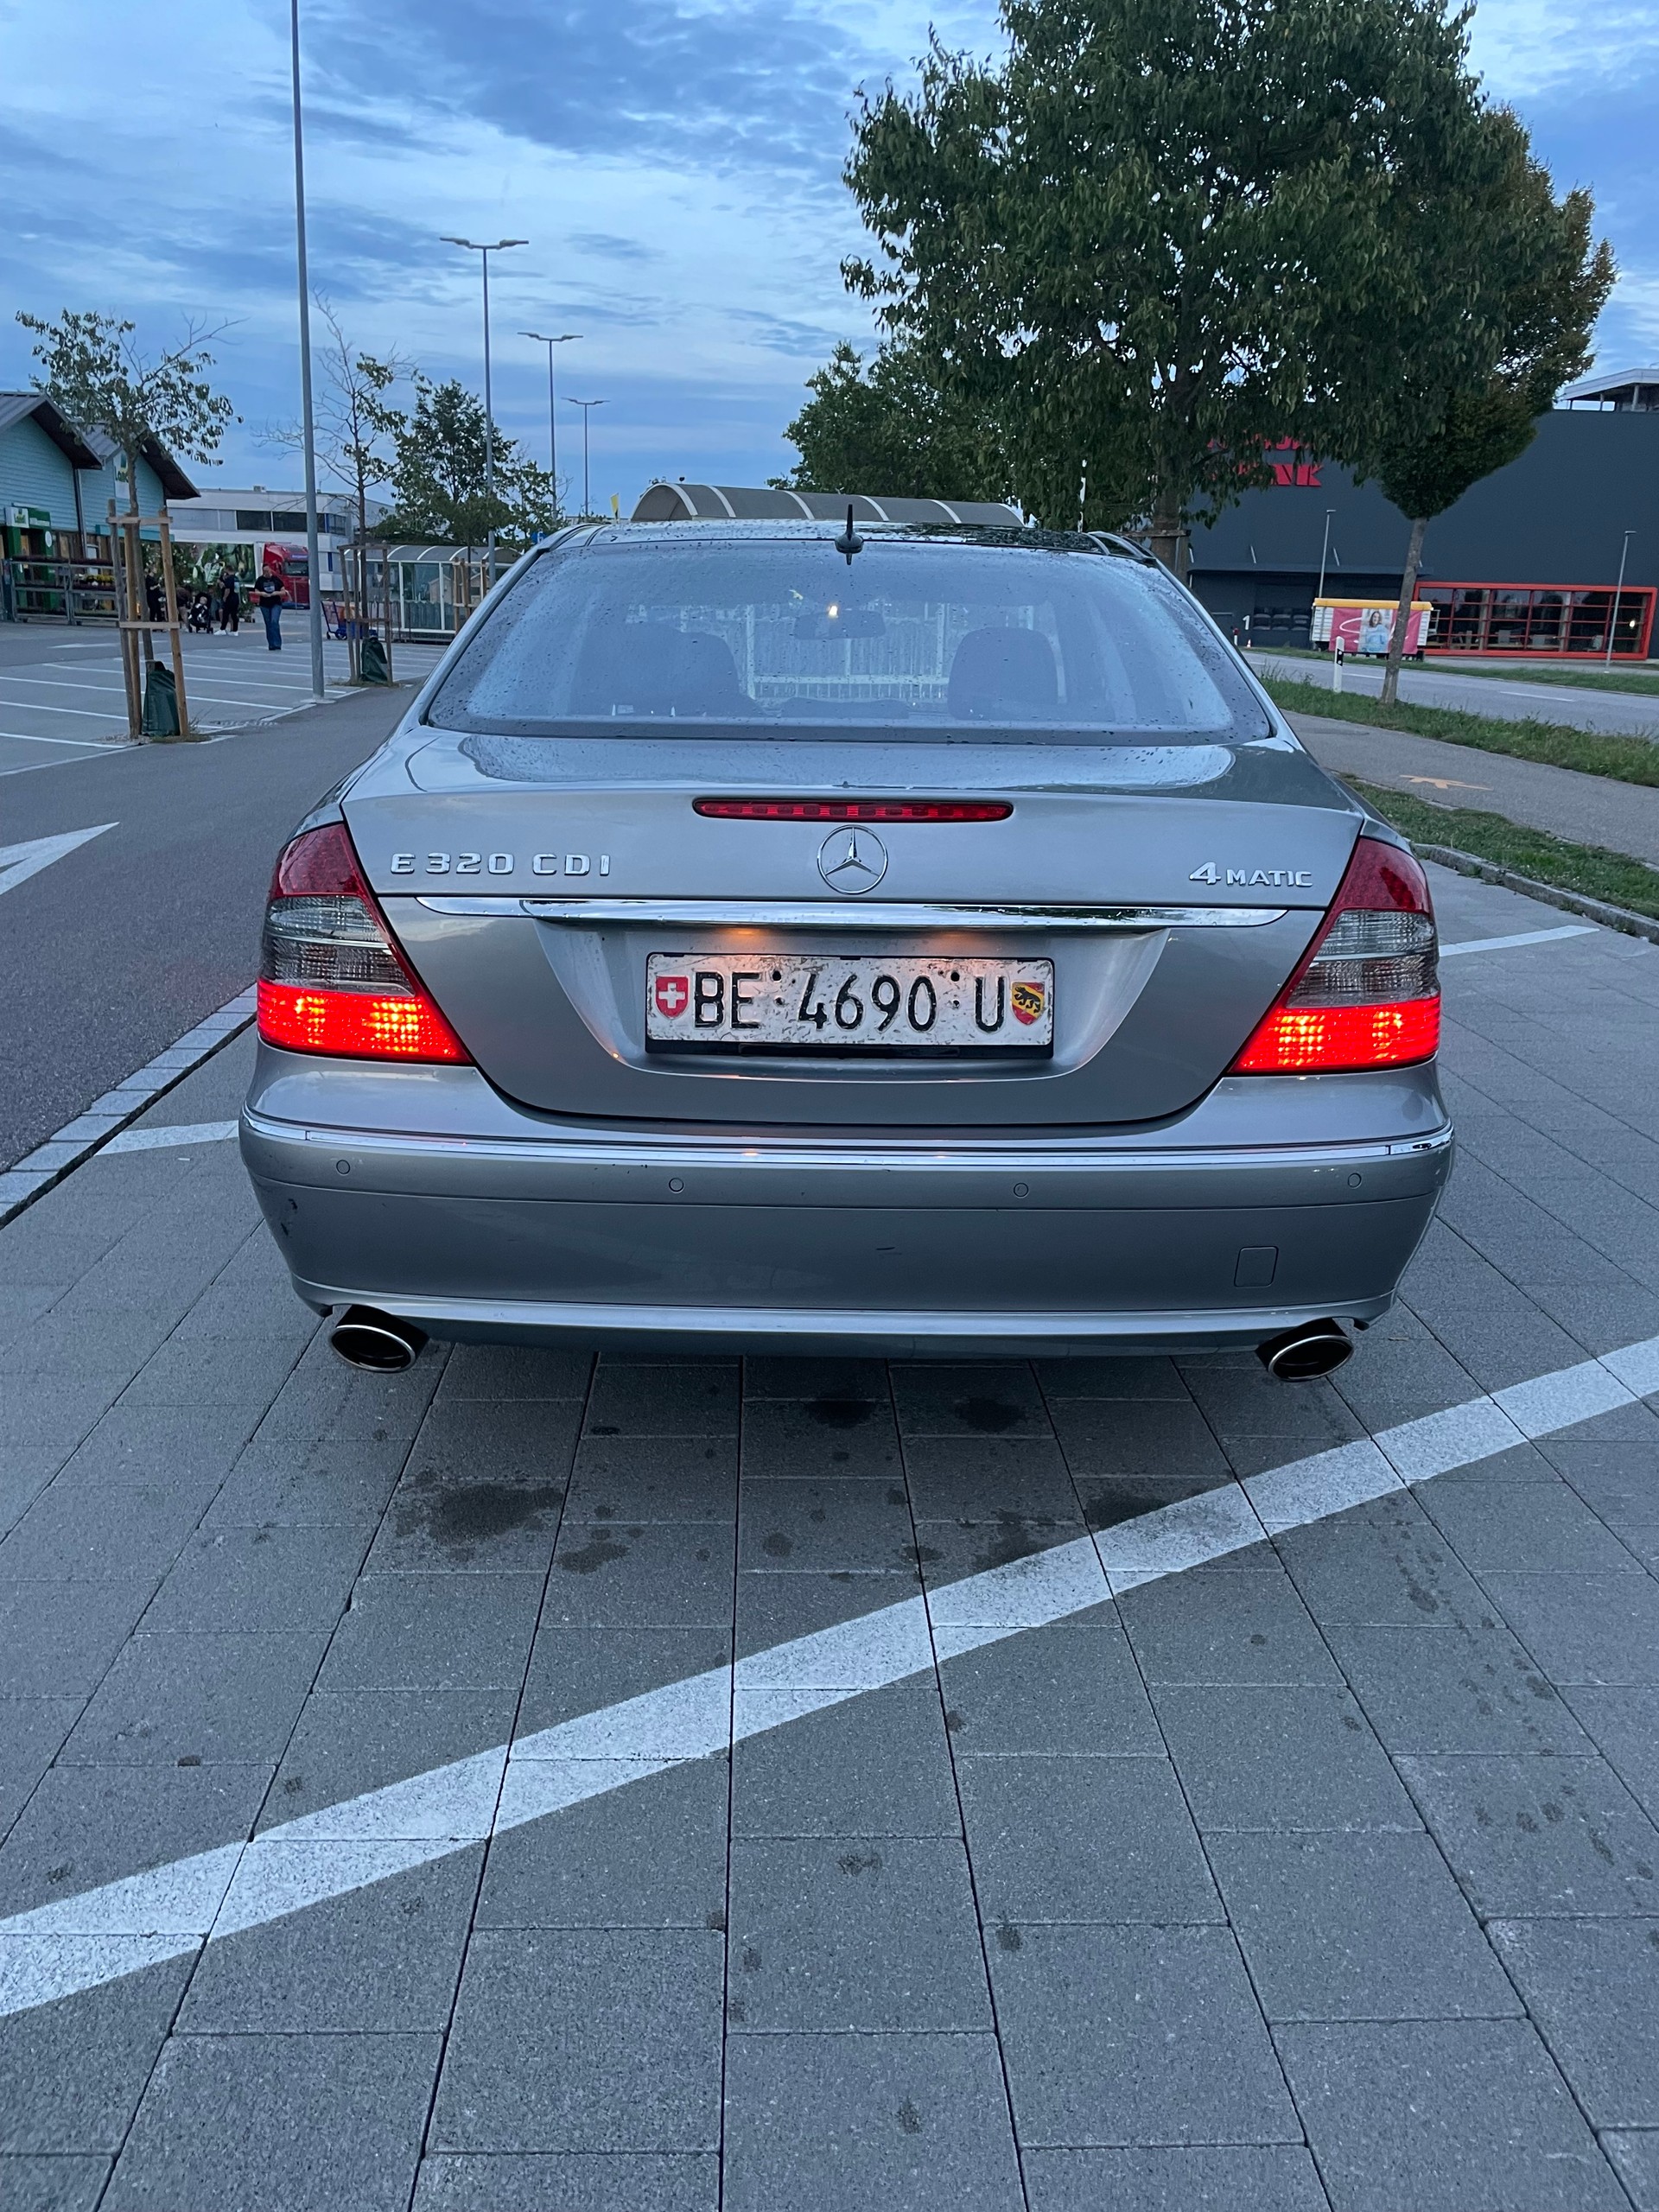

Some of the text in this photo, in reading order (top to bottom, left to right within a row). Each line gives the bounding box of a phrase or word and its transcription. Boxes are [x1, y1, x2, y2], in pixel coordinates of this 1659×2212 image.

[1243, 614, 1250, 630] 1
[391, 852, 610, 876] E 320 CDI
[694, 970, 1008, 1033] BE 4690 U
